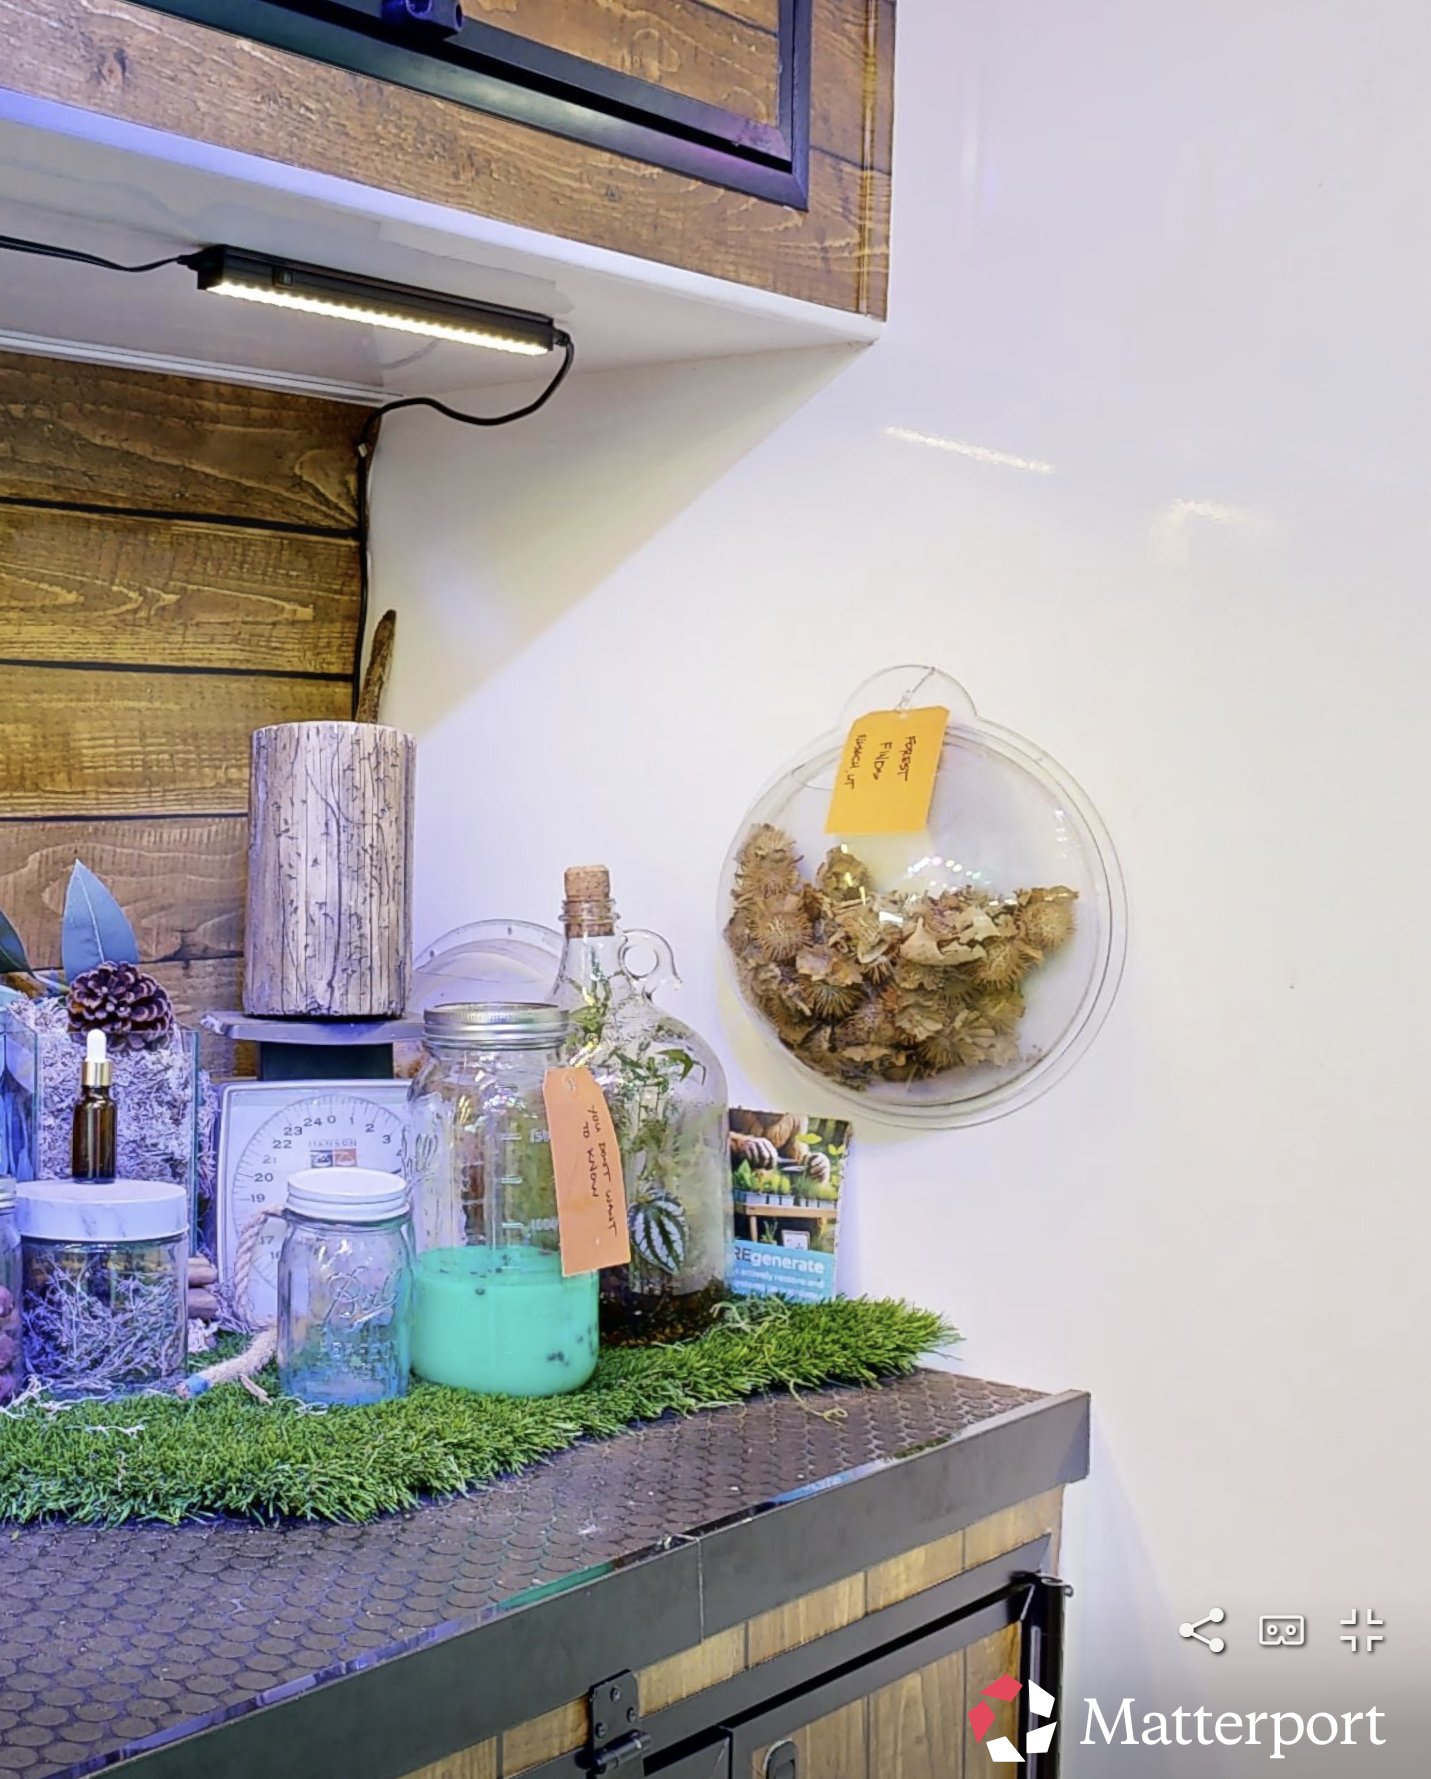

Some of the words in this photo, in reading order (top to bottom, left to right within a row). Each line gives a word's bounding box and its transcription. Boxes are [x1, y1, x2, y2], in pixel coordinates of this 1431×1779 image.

[897, 735, 917, 782] FOREST
[283, 1126, 303, 1136] 23
[303, 1117, 323, 1127] 24
[327, 1115, 337, 1124] 0
[349, 1116, 355, 1125] 1
[365, 1123, 376, 1133] 2
[382, 1134, 392, 1145] 3
[272, 1139, 293, 1149] 22
[262, 1154, 277, 1164] 21
[581, 1122, 590, 1139] TO
[586, 1148, 600, 1198] KNOW
[254, 1172, 274, 1183] 20
[586, 1104, 602, 1134] YOU
[604, 1192, 618, 1237] WANT
[251, 1193, 266, 1203] 19
[734, 1245, 825, 1275] REgenerate
